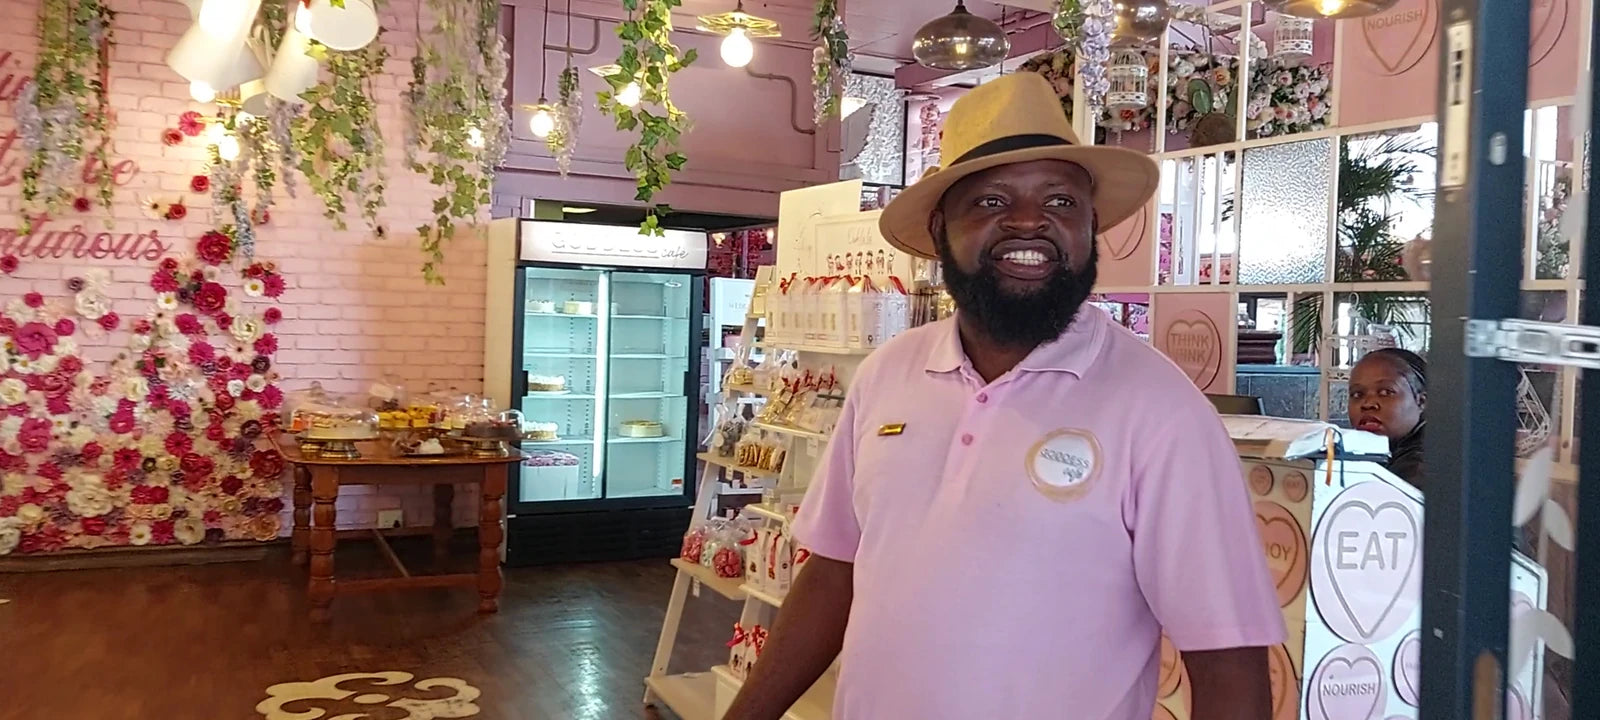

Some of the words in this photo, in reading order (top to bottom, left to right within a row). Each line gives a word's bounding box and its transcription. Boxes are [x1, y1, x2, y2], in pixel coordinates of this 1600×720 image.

[1367, 9, 1424, 31] NOURISH
[1170, 333, 1210, 349] THINK
[1336, 531, 1408, 570] EAT
[1322, 682, 1376, 697] NOURISH
